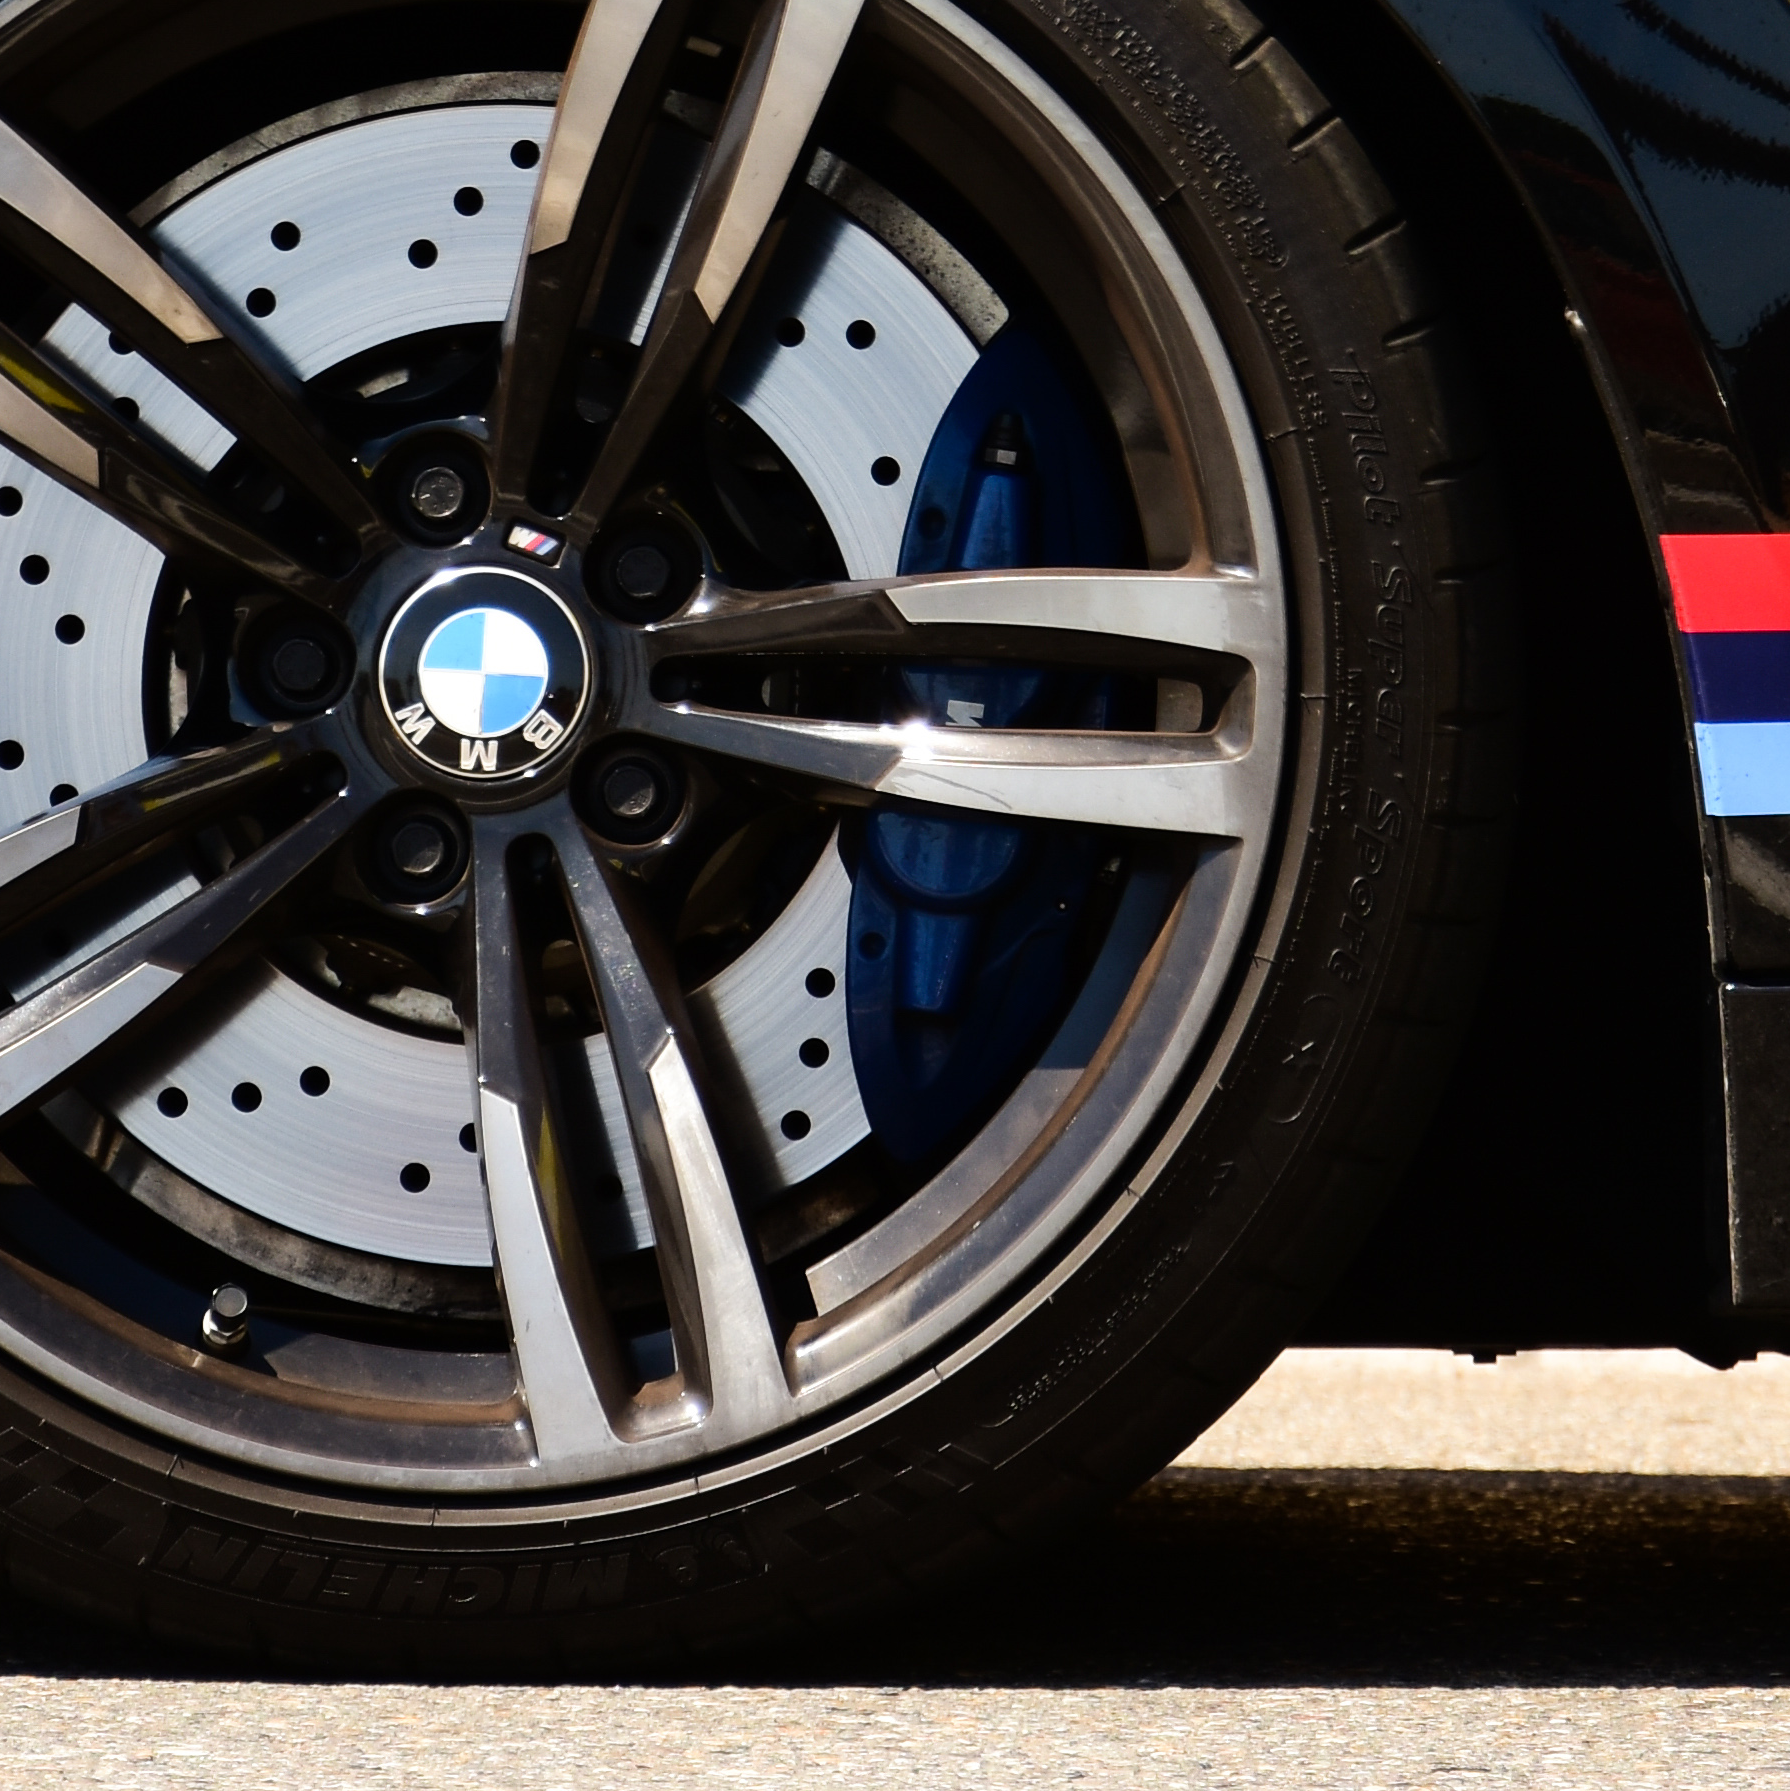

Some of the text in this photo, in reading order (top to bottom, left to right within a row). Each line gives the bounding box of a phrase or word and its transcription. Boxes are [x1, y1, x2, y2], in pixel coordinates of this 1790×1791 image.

[1328, 367, 1414, 984] Pilot Super Sport
[395, 702, 564, 772] BMW
[166, 1522, 633, 1615] MICHELIN
